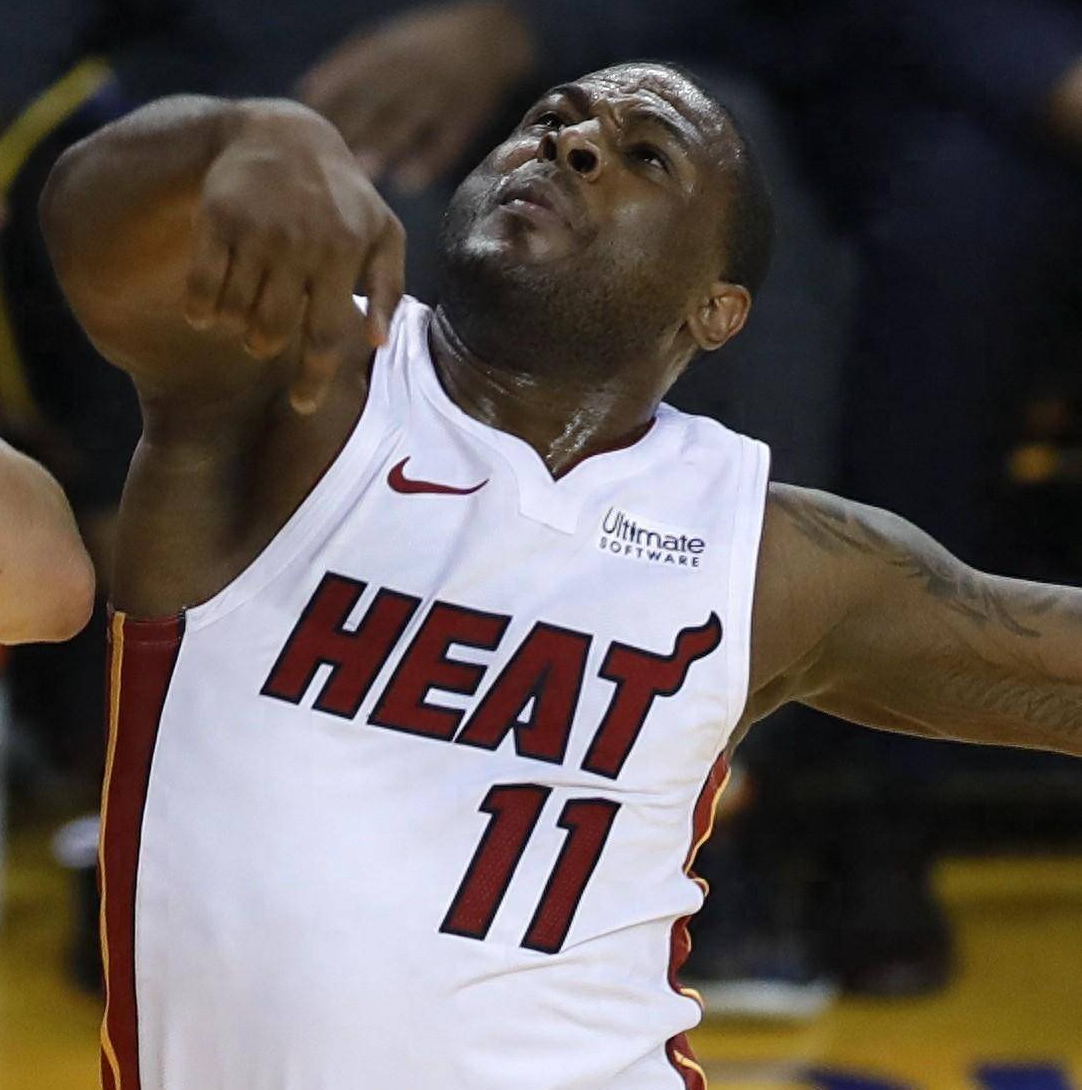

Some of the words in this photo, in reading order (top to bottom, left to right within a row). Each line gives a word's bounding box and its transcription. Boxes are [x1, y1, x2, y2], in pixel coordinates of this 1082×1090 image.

[599, 536, 700, 568] SOFTWARE
[602, 506, 705, 554] Ultimate
[259, 570, 724, 781] HEAT
[437, 782, 622, 956] 11
